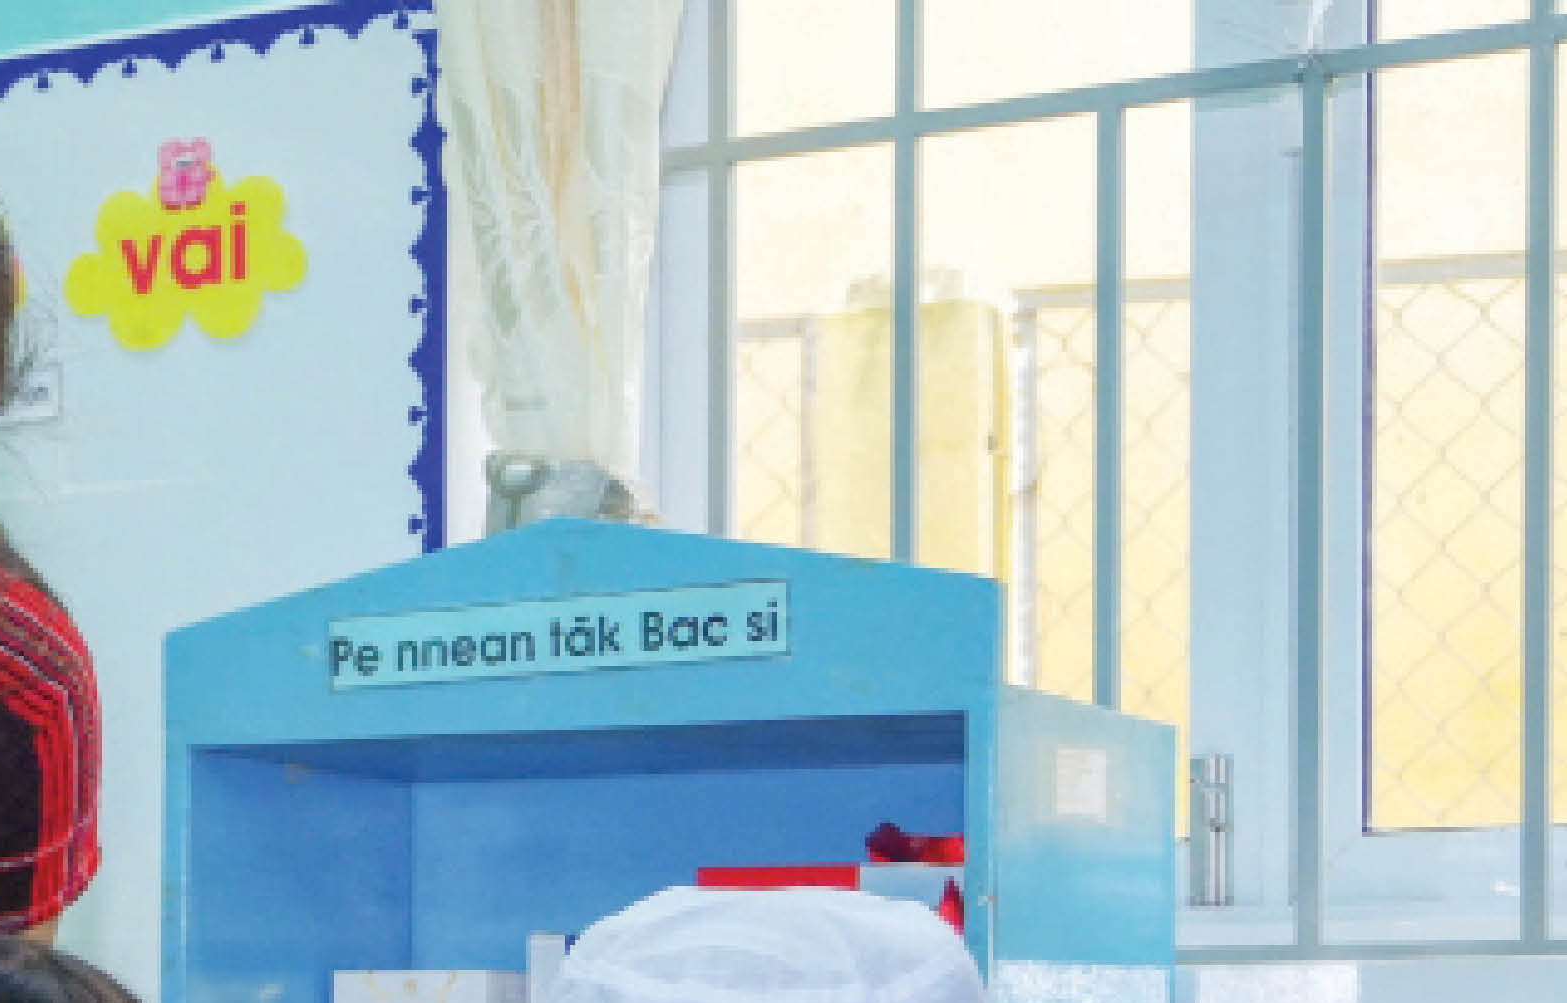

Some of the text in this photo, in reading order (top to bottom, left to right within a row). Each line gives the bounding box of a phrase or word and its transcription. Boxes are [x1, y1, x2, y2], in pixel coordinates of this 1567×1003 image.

[119, 201, 249, 294] vai
[330, 636, 380, 677] Pe
[640, 611, 728, 653] Bac
[746, 599, 779, 643] si
